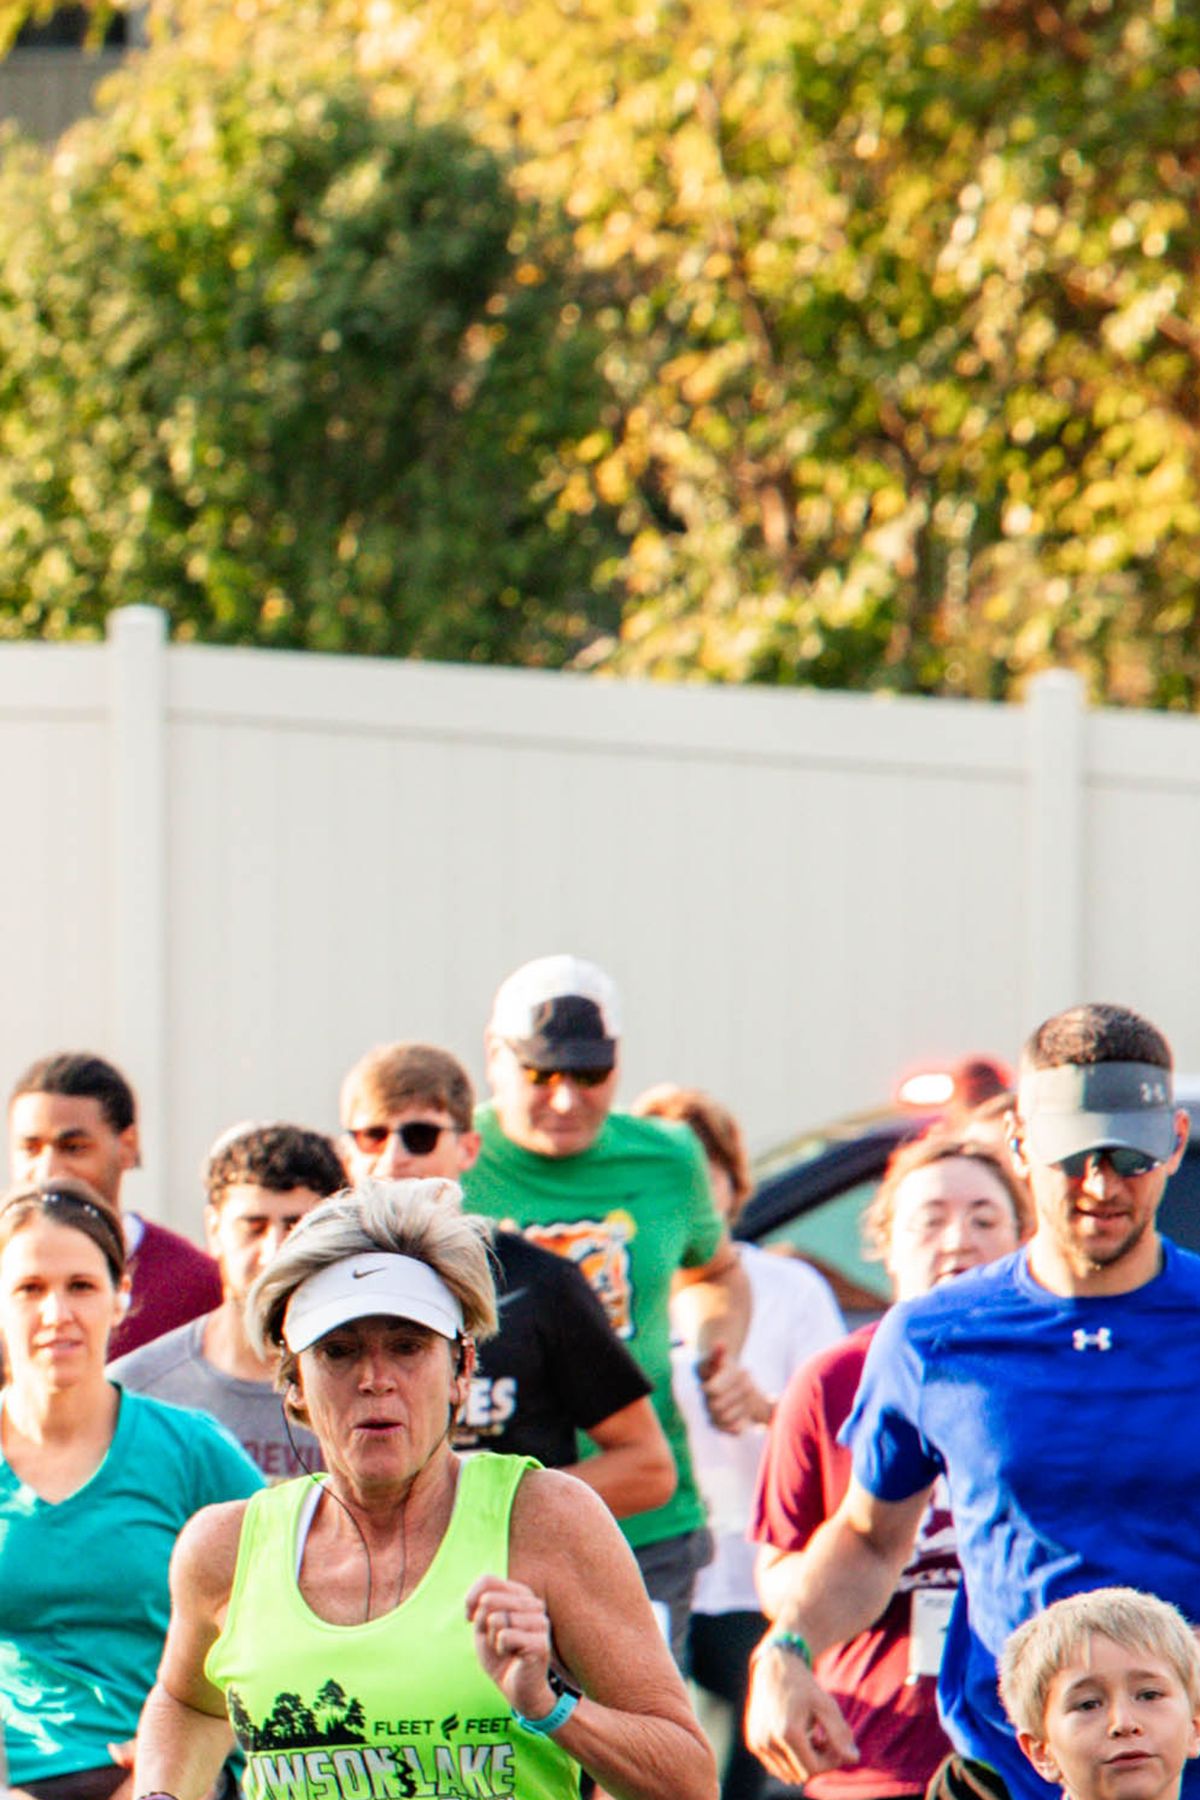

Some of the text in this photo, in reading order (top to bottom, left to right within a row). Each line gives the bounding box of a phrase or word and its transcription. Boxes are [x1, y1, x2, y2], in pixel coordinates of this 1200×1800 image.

[456, 1376, 517, 1426] ES
[373, 1717, 512, 1736] FLEET FEET
[403, 1744, 516, 1799] LAKE
